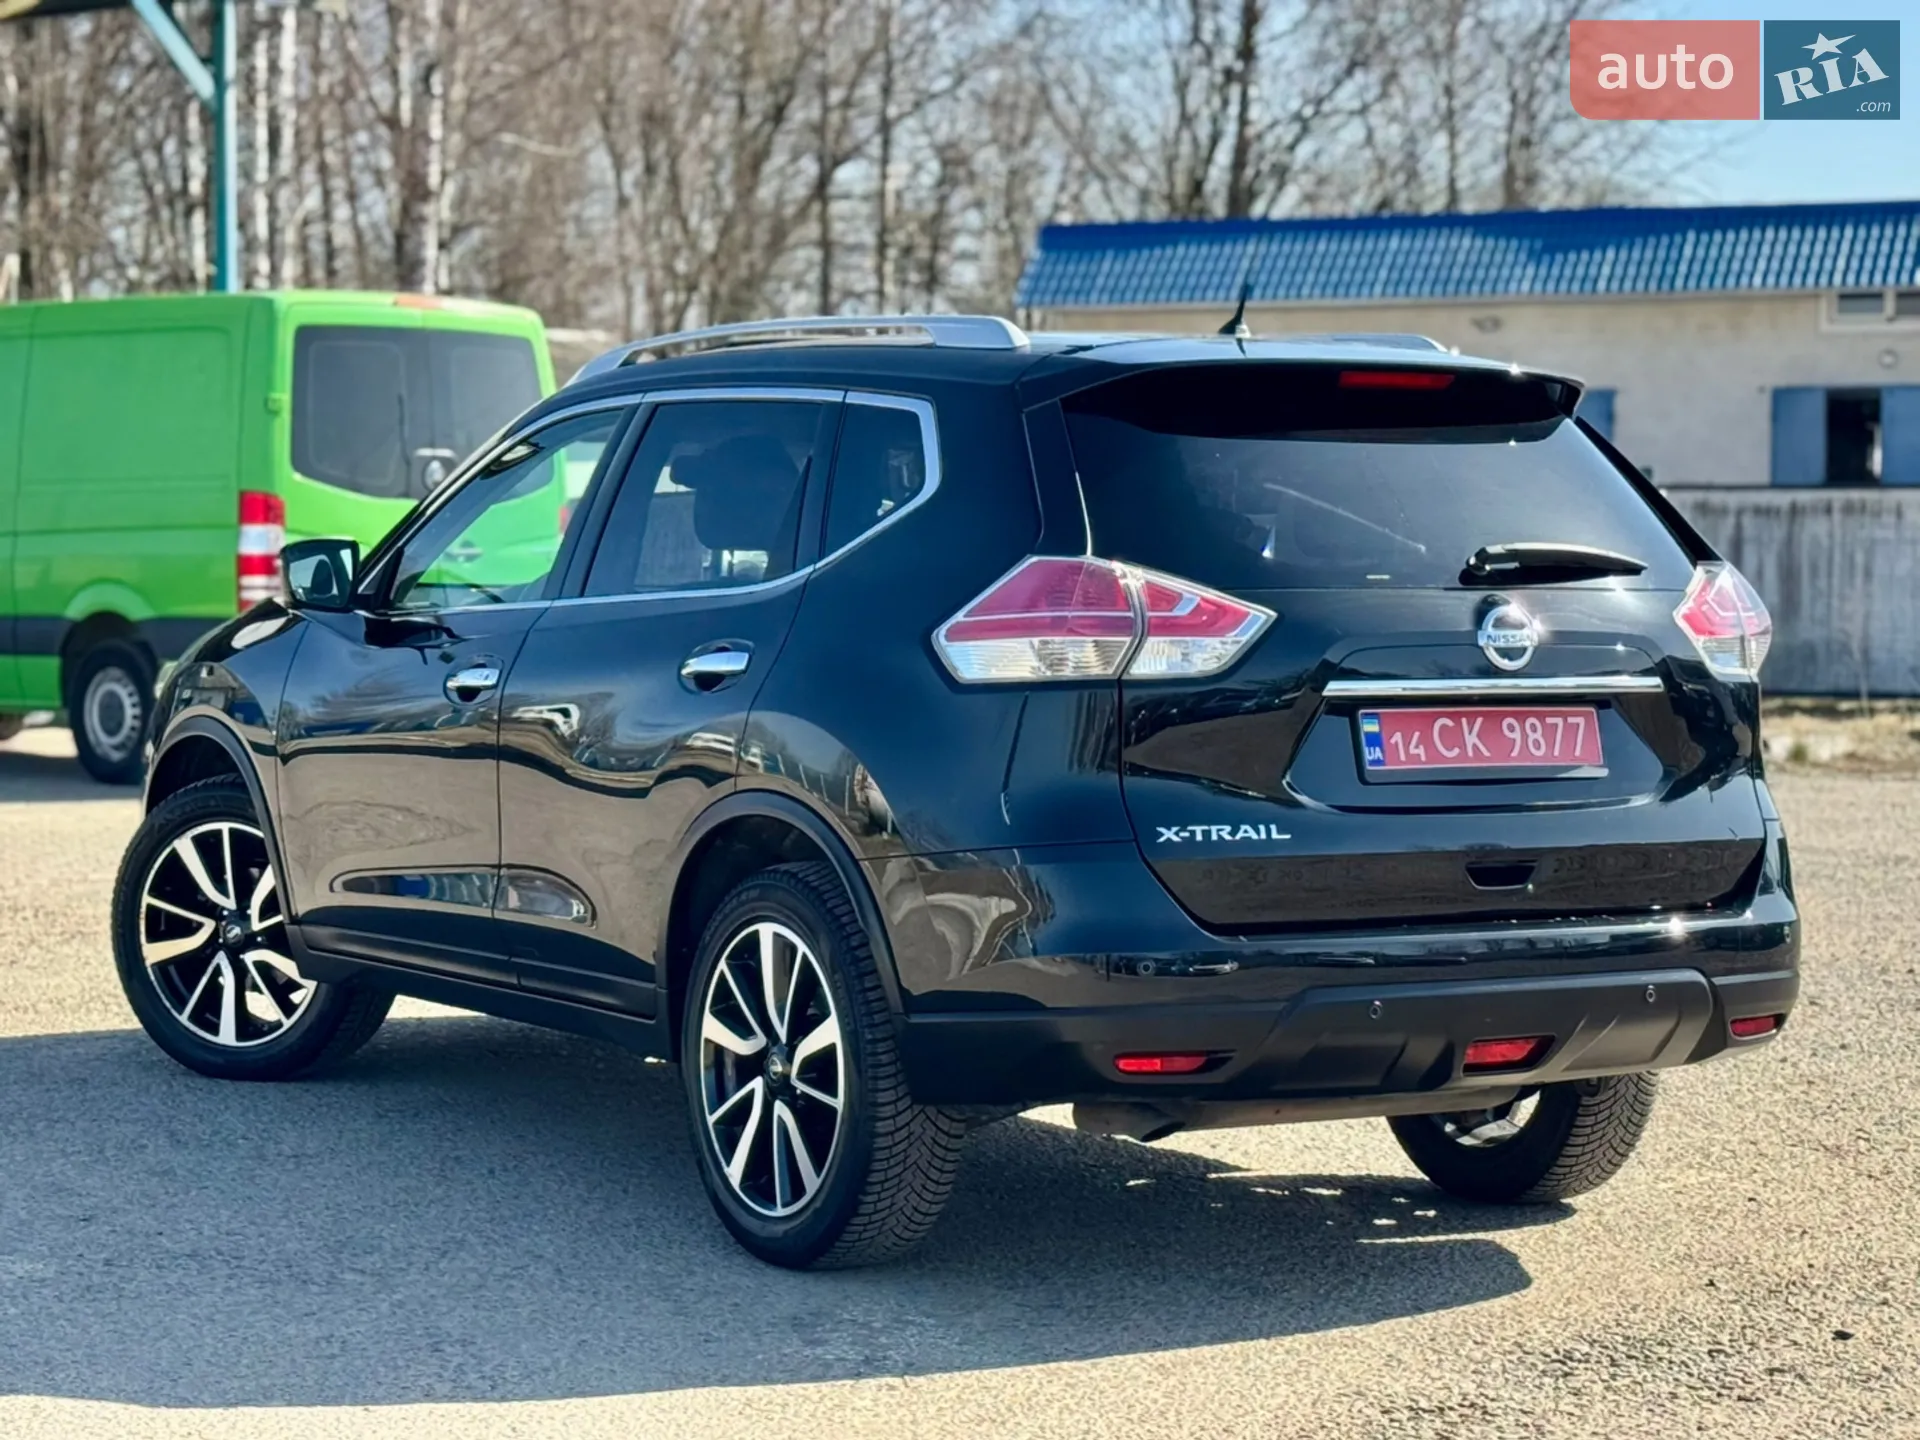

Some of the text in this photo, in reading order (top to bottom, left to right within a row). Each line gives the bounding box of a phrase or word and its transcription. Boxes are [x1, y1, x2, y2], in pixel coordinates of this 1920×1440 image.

[1390, 716, 1586, 762] 14 CK 9877
[1366, 747, 1384, 761] UA
[1156, 824, 1291, 843] X-TRAIL
